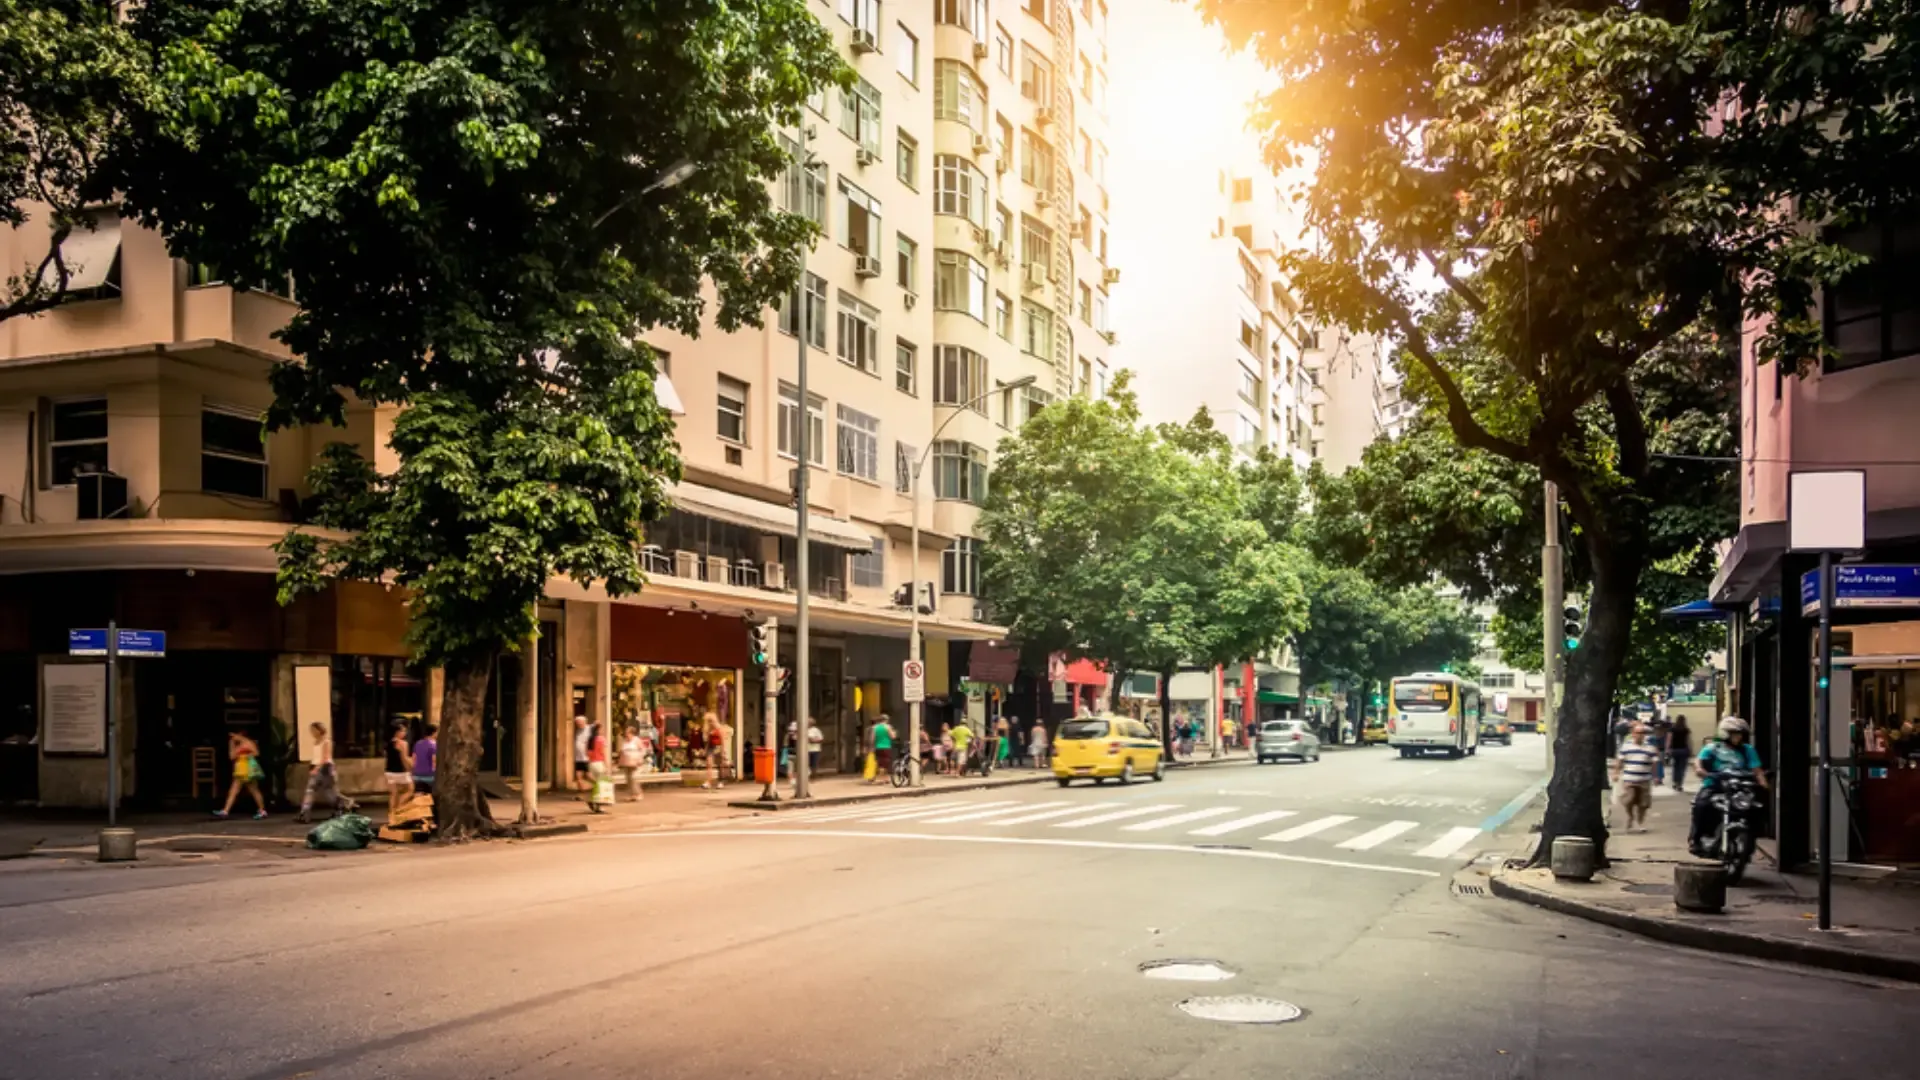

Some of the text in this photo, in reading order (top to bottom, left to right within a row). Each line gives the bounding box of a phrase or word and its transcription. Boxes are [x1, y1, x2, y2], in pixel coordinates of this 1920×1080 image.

[1838, 567, 1856, 575] Rua
[1837, 574, 1896, 583] Paula Freitas
